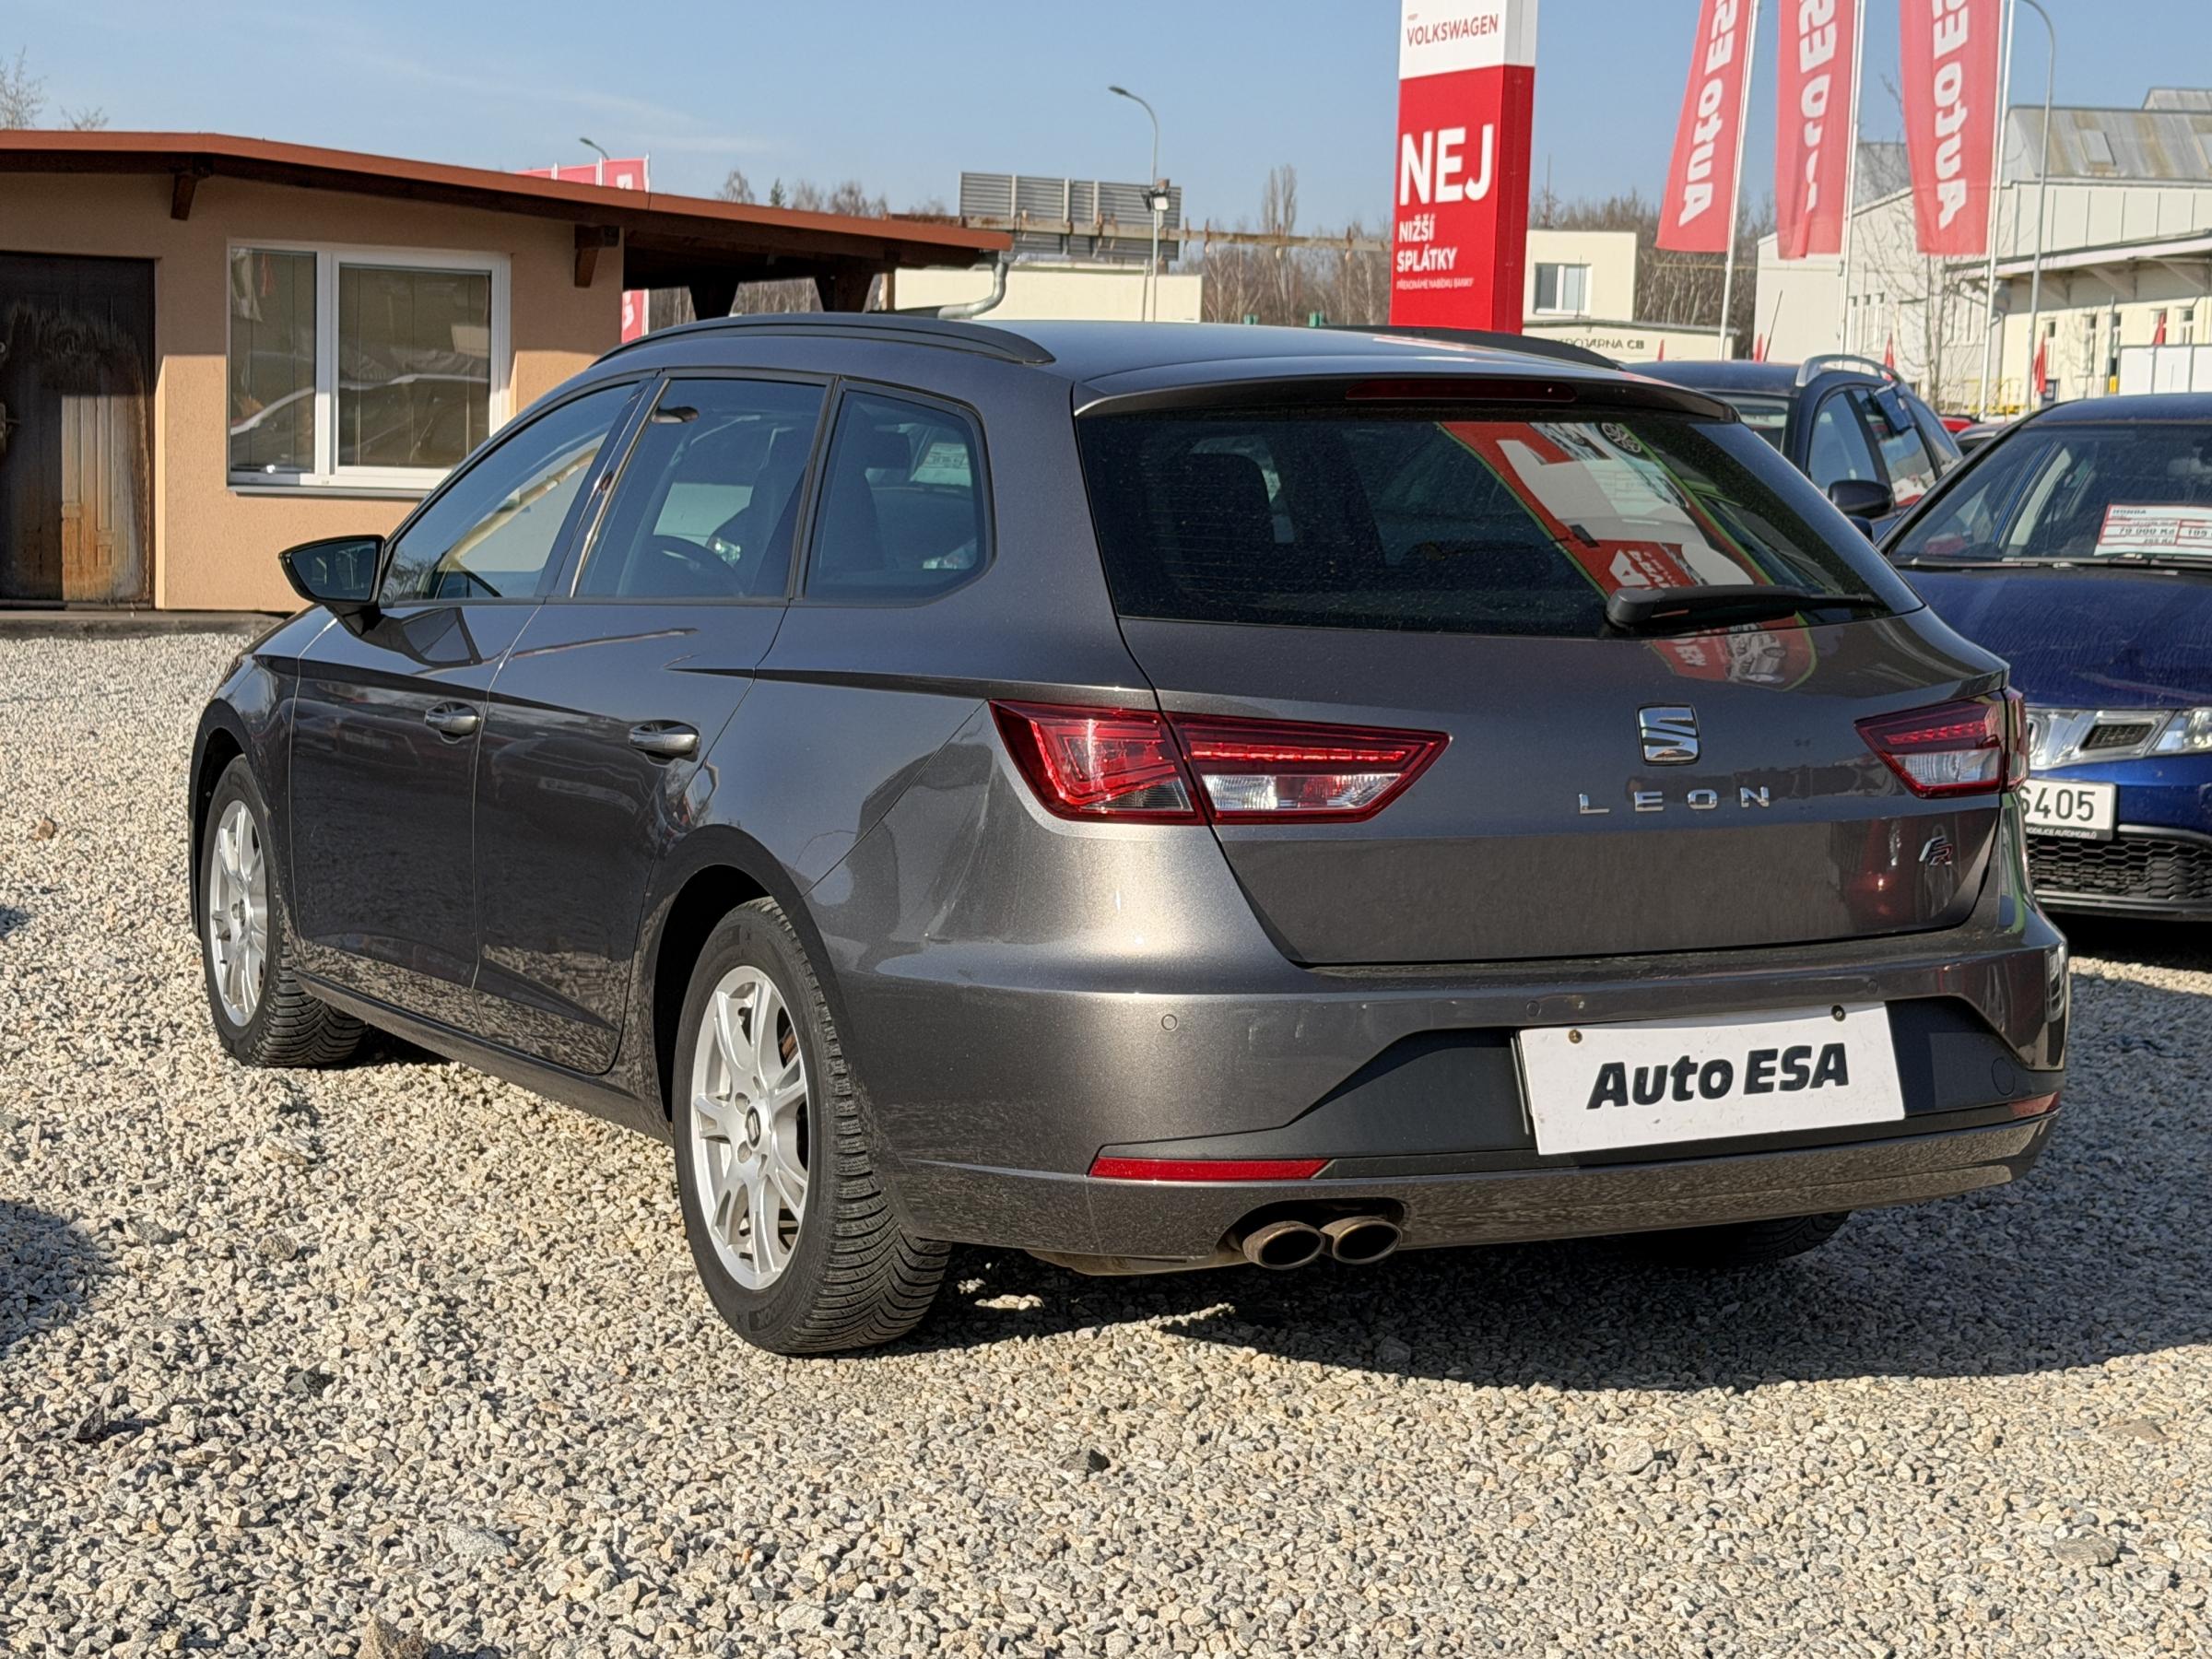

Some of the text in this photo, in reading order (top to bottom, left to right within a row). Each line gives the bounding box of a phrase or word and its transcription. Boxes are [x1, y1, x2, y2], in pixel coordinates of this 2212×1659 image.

[1406, 13, 1499, 47] VOLKSWAGEN
[1399, 124, 1494, 206] NEJ
[1398, 213, 1436, 243] NIŽŠÍ
[1396, 243, 1458, 273] SPLÁTKY
[1578, 786, 1770, 815] LEON
[2019, 785, 2096, 822] 6405
[1585, 1042, 1850, 1110] Auto ESA
